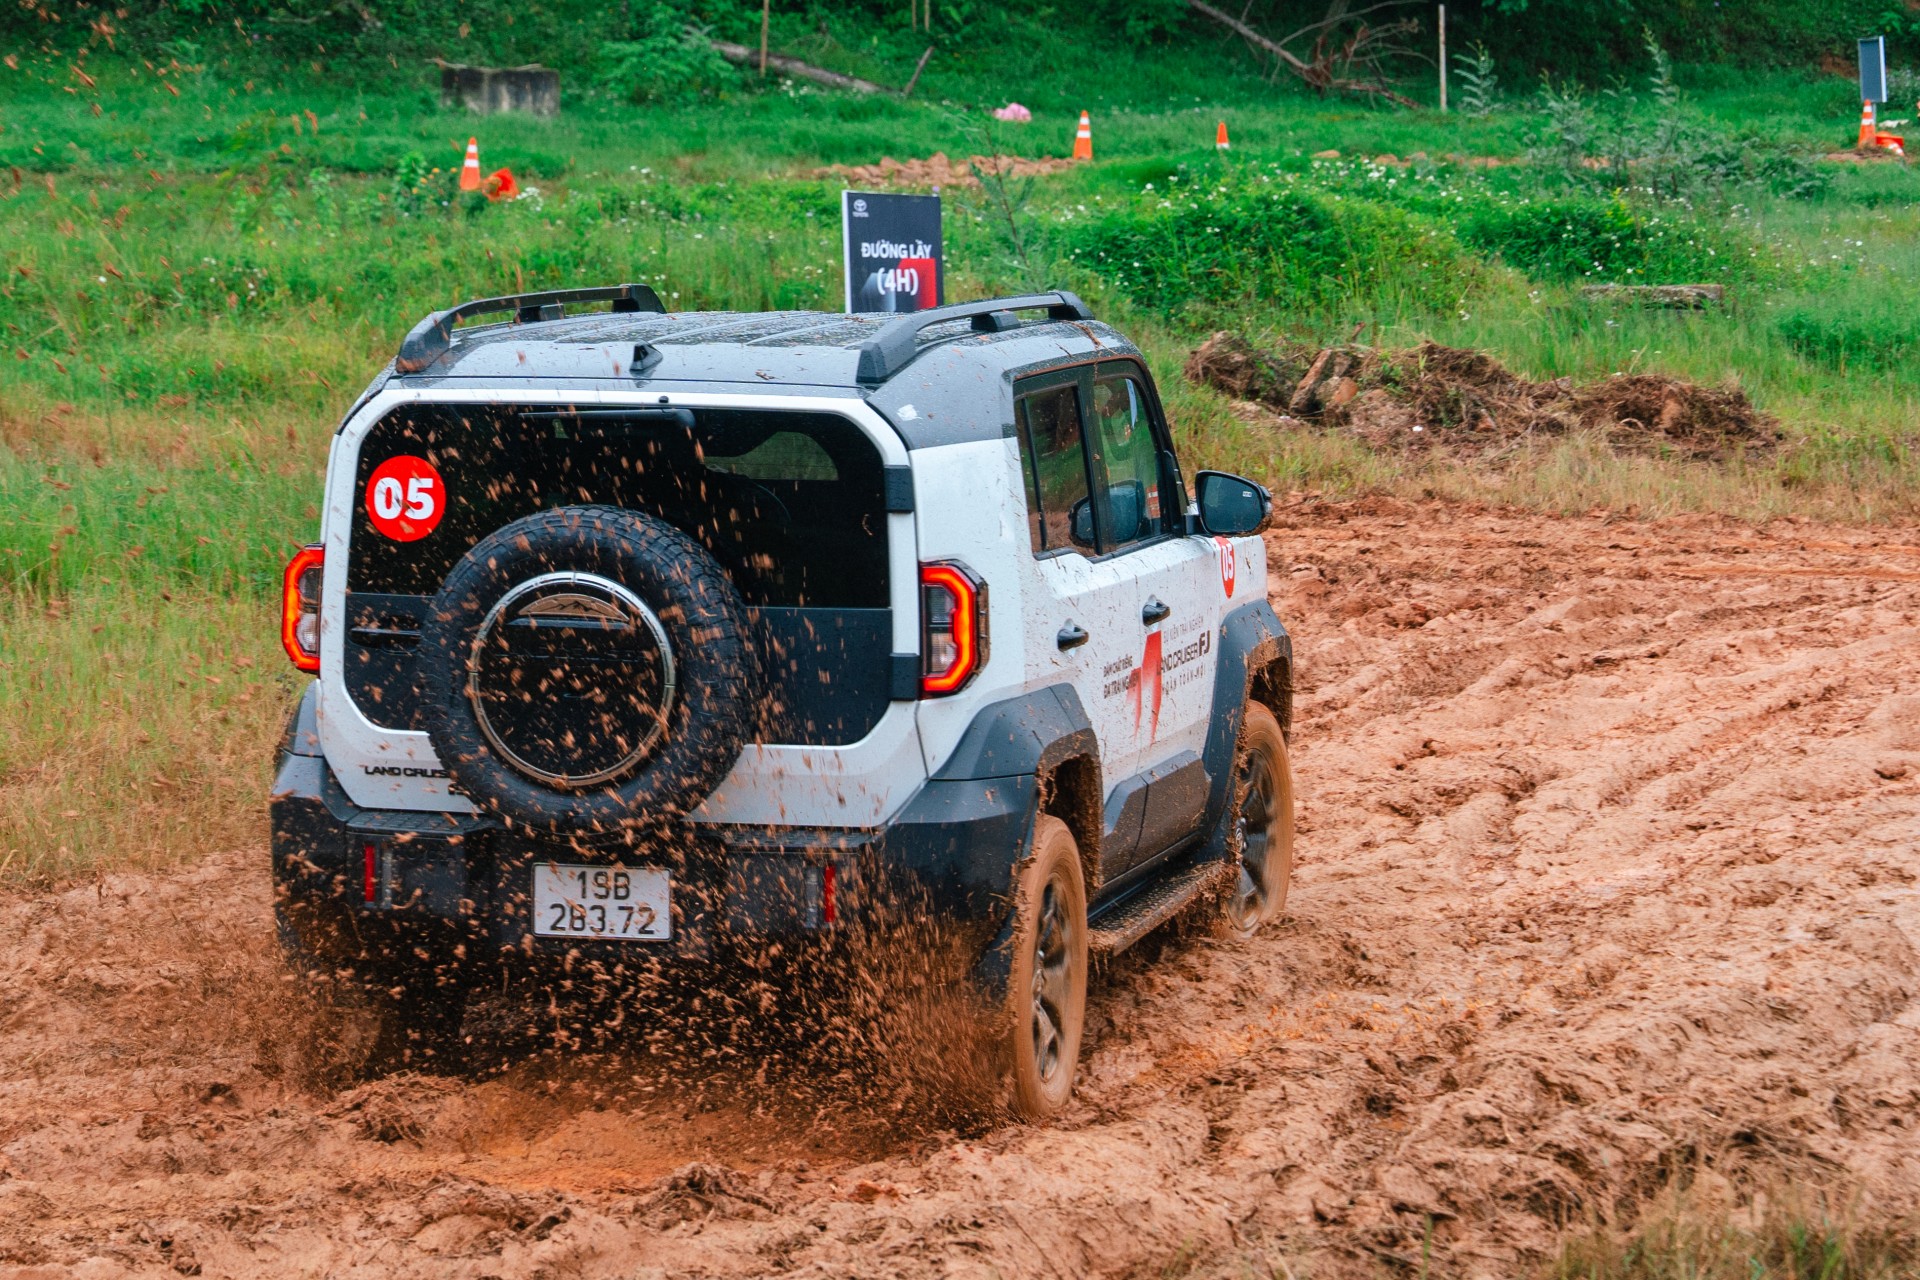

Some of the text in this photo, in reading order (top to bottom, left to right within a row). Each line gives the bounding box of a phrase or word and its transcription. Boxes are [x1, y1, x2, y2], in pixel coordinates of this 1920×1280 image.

[861, 239, 932, 259] ĐƯỜNG LẦY
[877, 267, 918, 296] (4H)
[374, 477, 434, 520] 05
[1221, 543, 1233, 581] 05
[1156, 630, 1210, 676] LAND CRUISER FJ
[364, 766, 450, 778] LAND CRUIS
[577, 871, 630, 900] 19B
